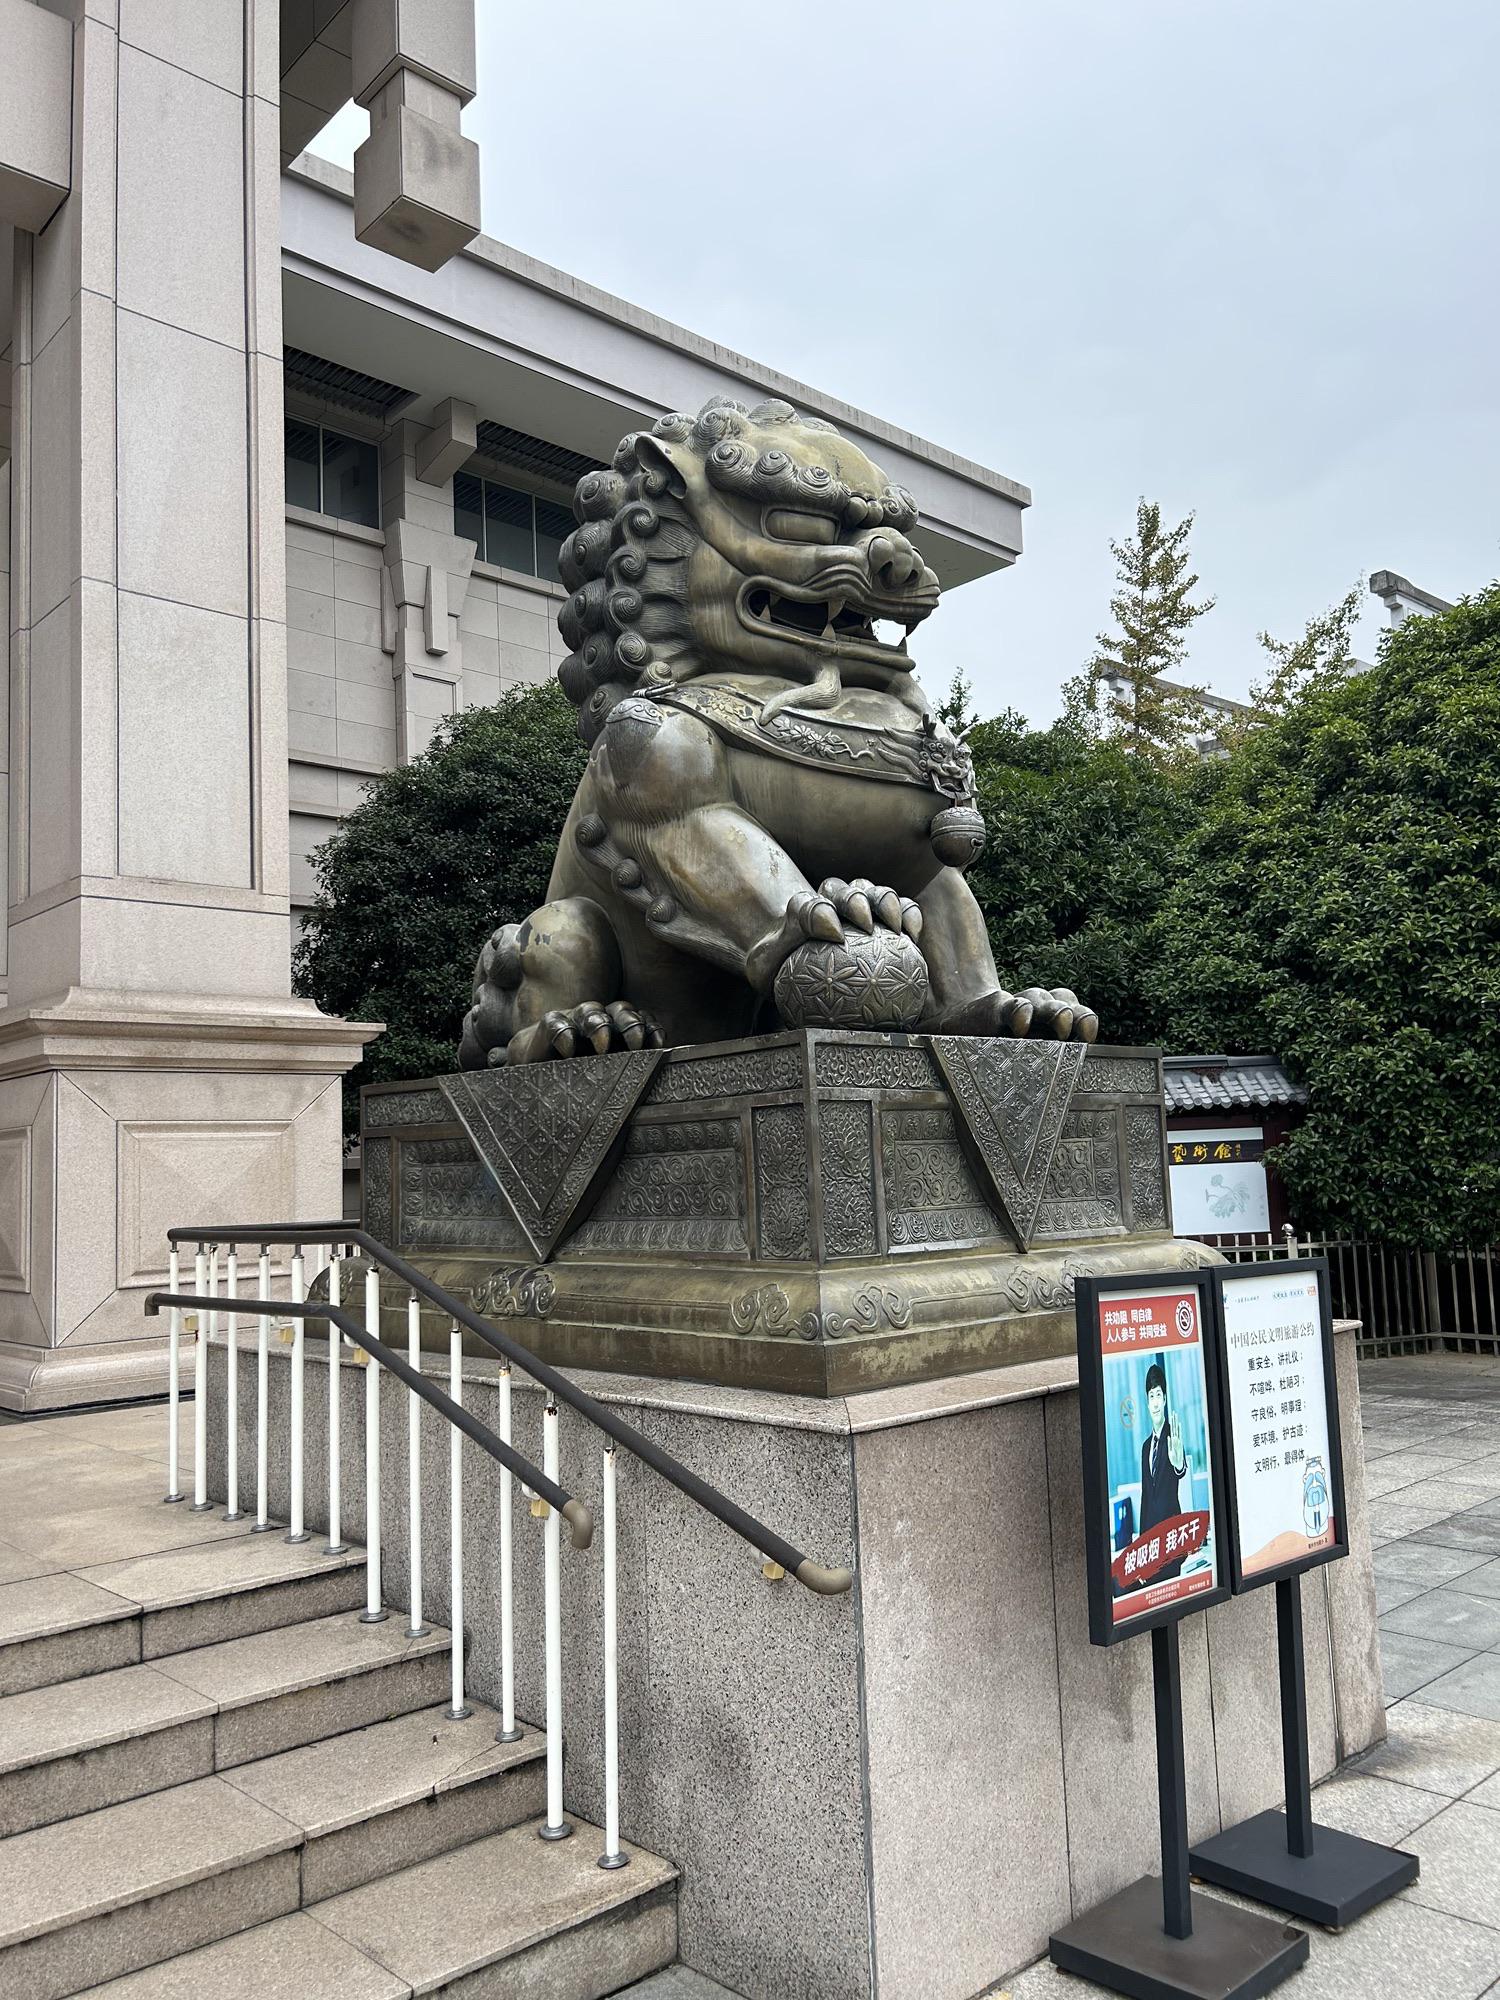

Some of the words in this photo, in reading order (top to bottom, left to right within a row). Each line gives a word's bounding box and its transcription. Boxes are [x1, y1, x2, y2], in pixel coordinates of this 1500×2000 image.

[1104, 1310, 1128, 1326] 共劝阻
[1130, 1308, 1153, 1323] 同自律
[1106, 1326, 1136, 1344] 人人参与
[1139, 1323, 1168, 1339] 共同受益
[1230, 1321, 1315, 1349] 中国公民文明旅游公约
[1124, 1537, 1160, 1576] 被吸烟
[1165, 1518, 1200, 1554] 我不干
